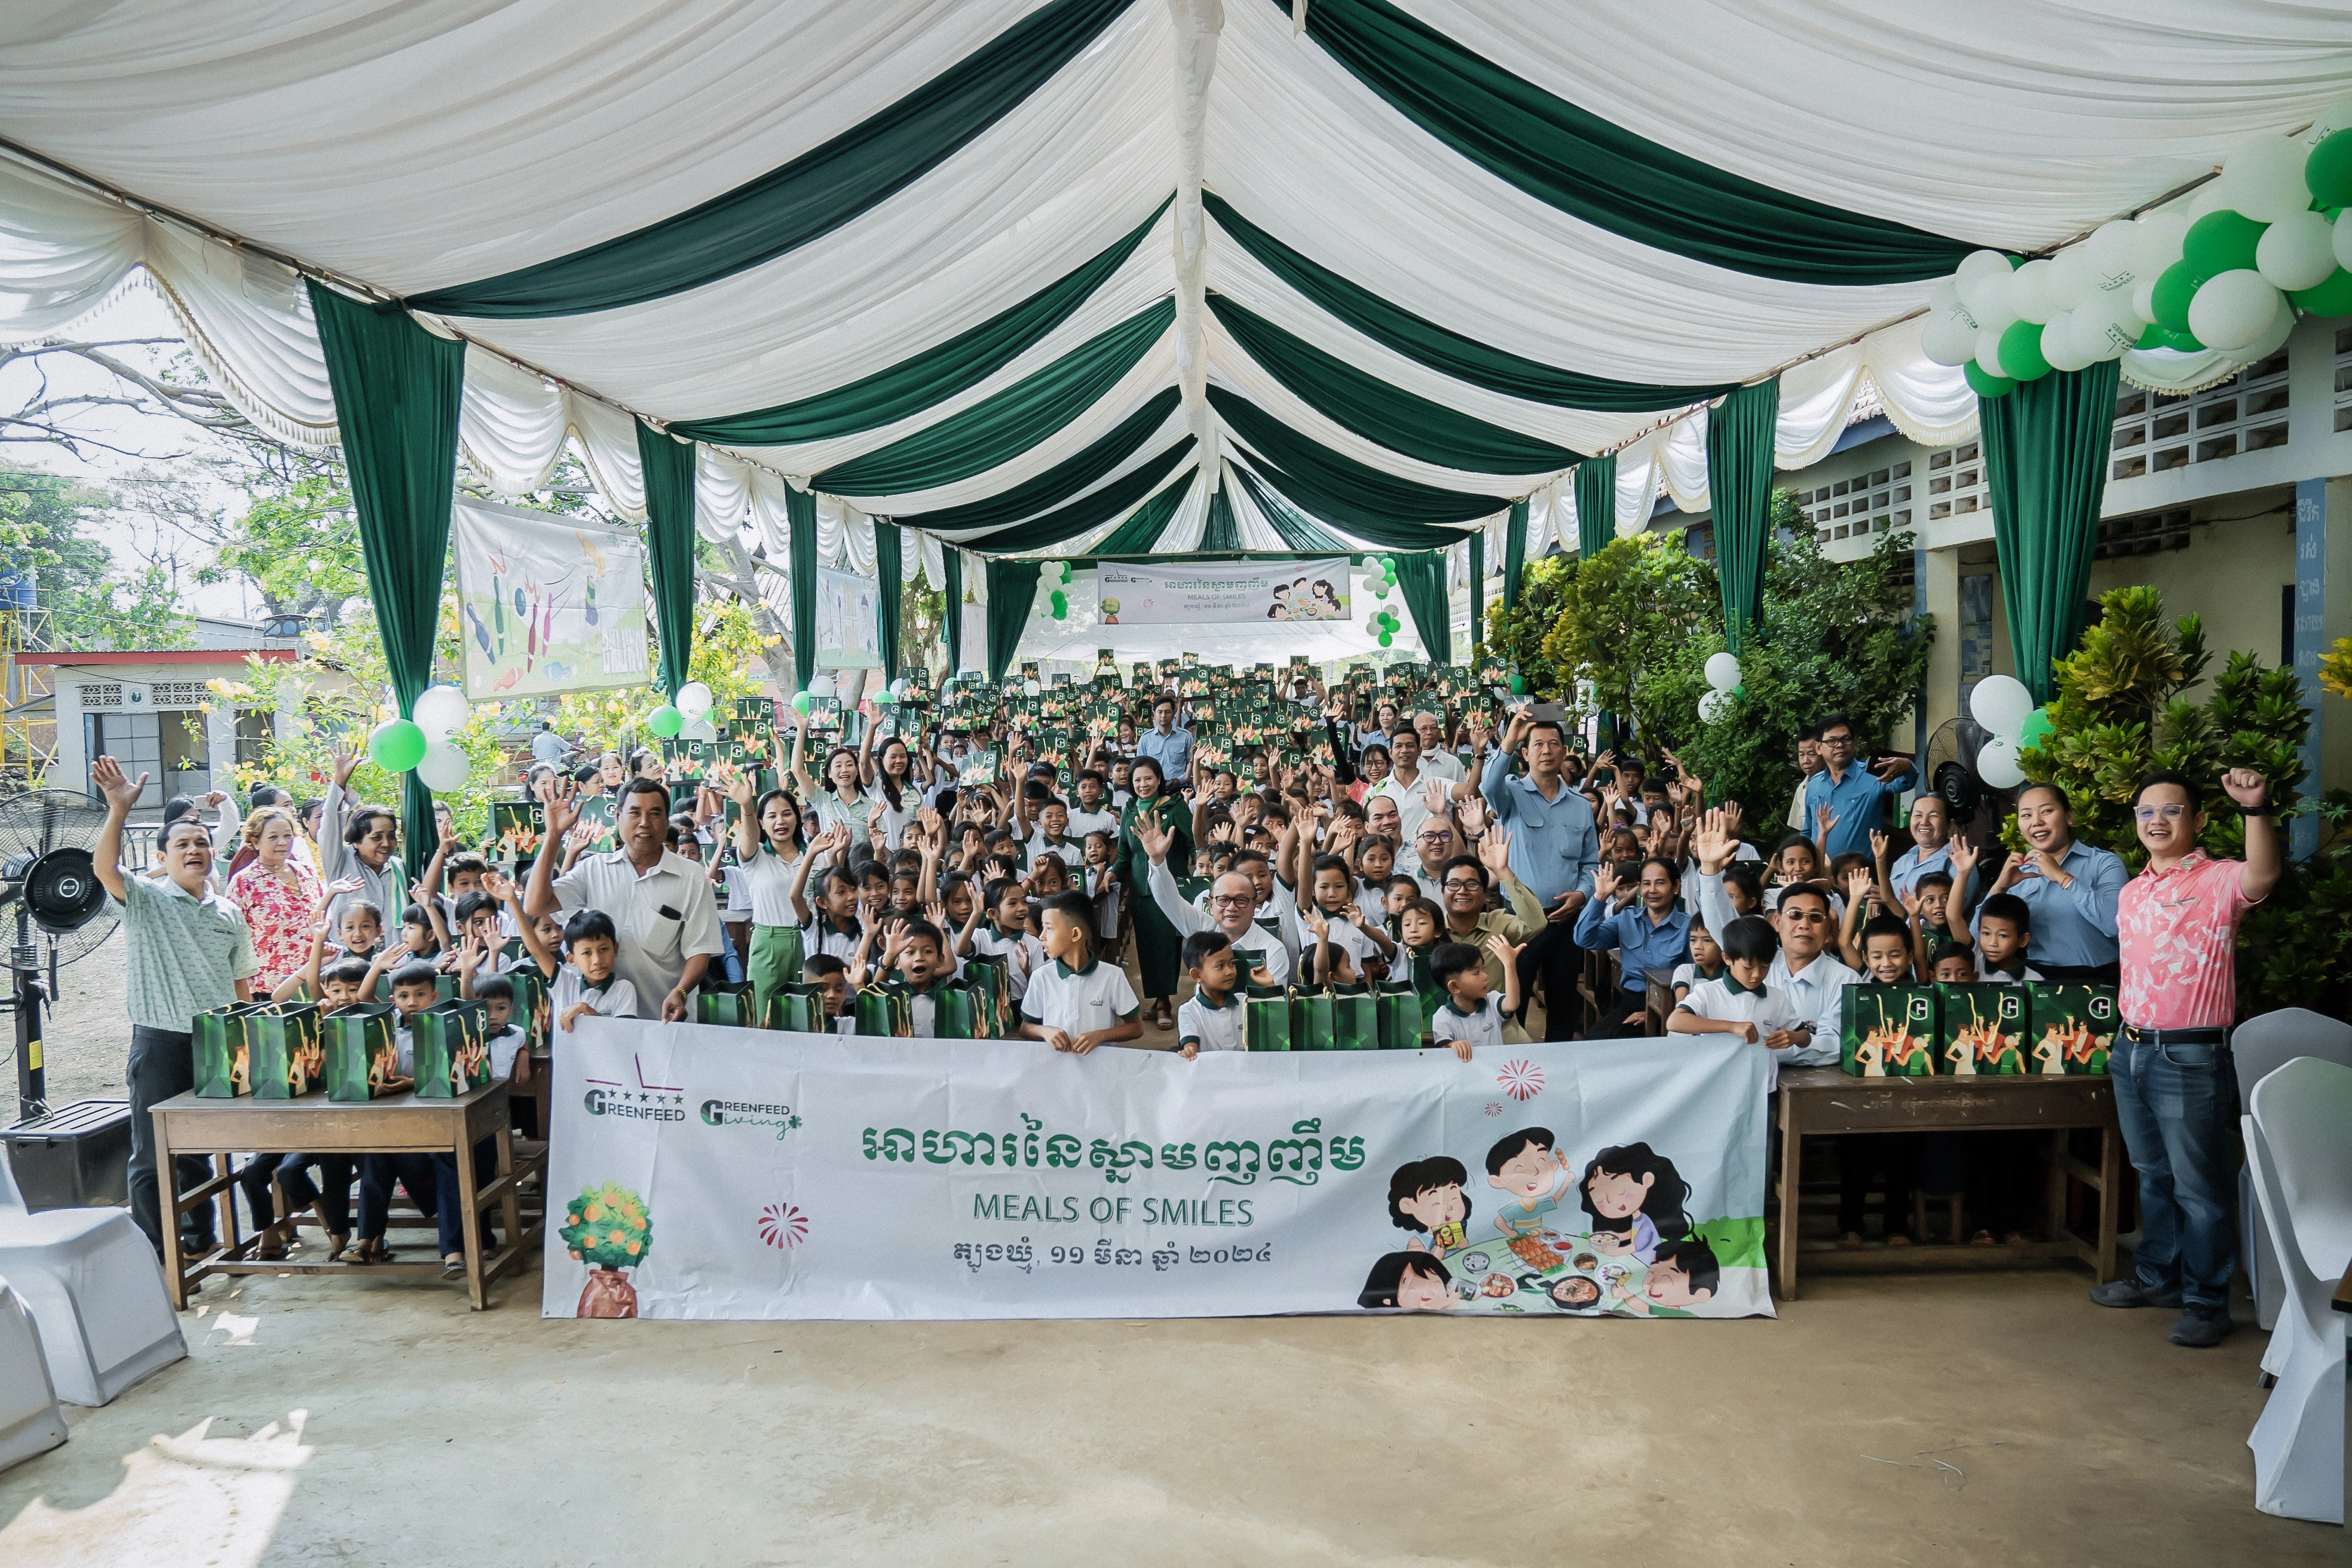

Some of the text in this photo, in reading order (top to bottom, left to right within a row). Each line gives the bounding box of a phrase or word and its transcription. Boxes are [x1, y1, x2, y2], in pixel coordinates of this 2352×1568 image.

[1910, 998, 1928, 1020] G
[2002, 996, 2019, 1018] G
[2088, 997, 2110, 1019] G
[584, 1089, 685, 1122] GREENFEED
[700, 1100, 790, 1126] GREENFEED
[862, 1112, 1366, 1186] អាហារនៃស្នាមញញឹម
[973, 1193, 1255, 1227] MEALS OF SMILES
[1051, 1246, 1085, 1264] ១១
[1094, 1238, 1142, 1265] មីនា
[1152, 1241, 1179, 1271] ឆ្នាំ
[1190, 1242, 1271, 1264] ២០២៤
